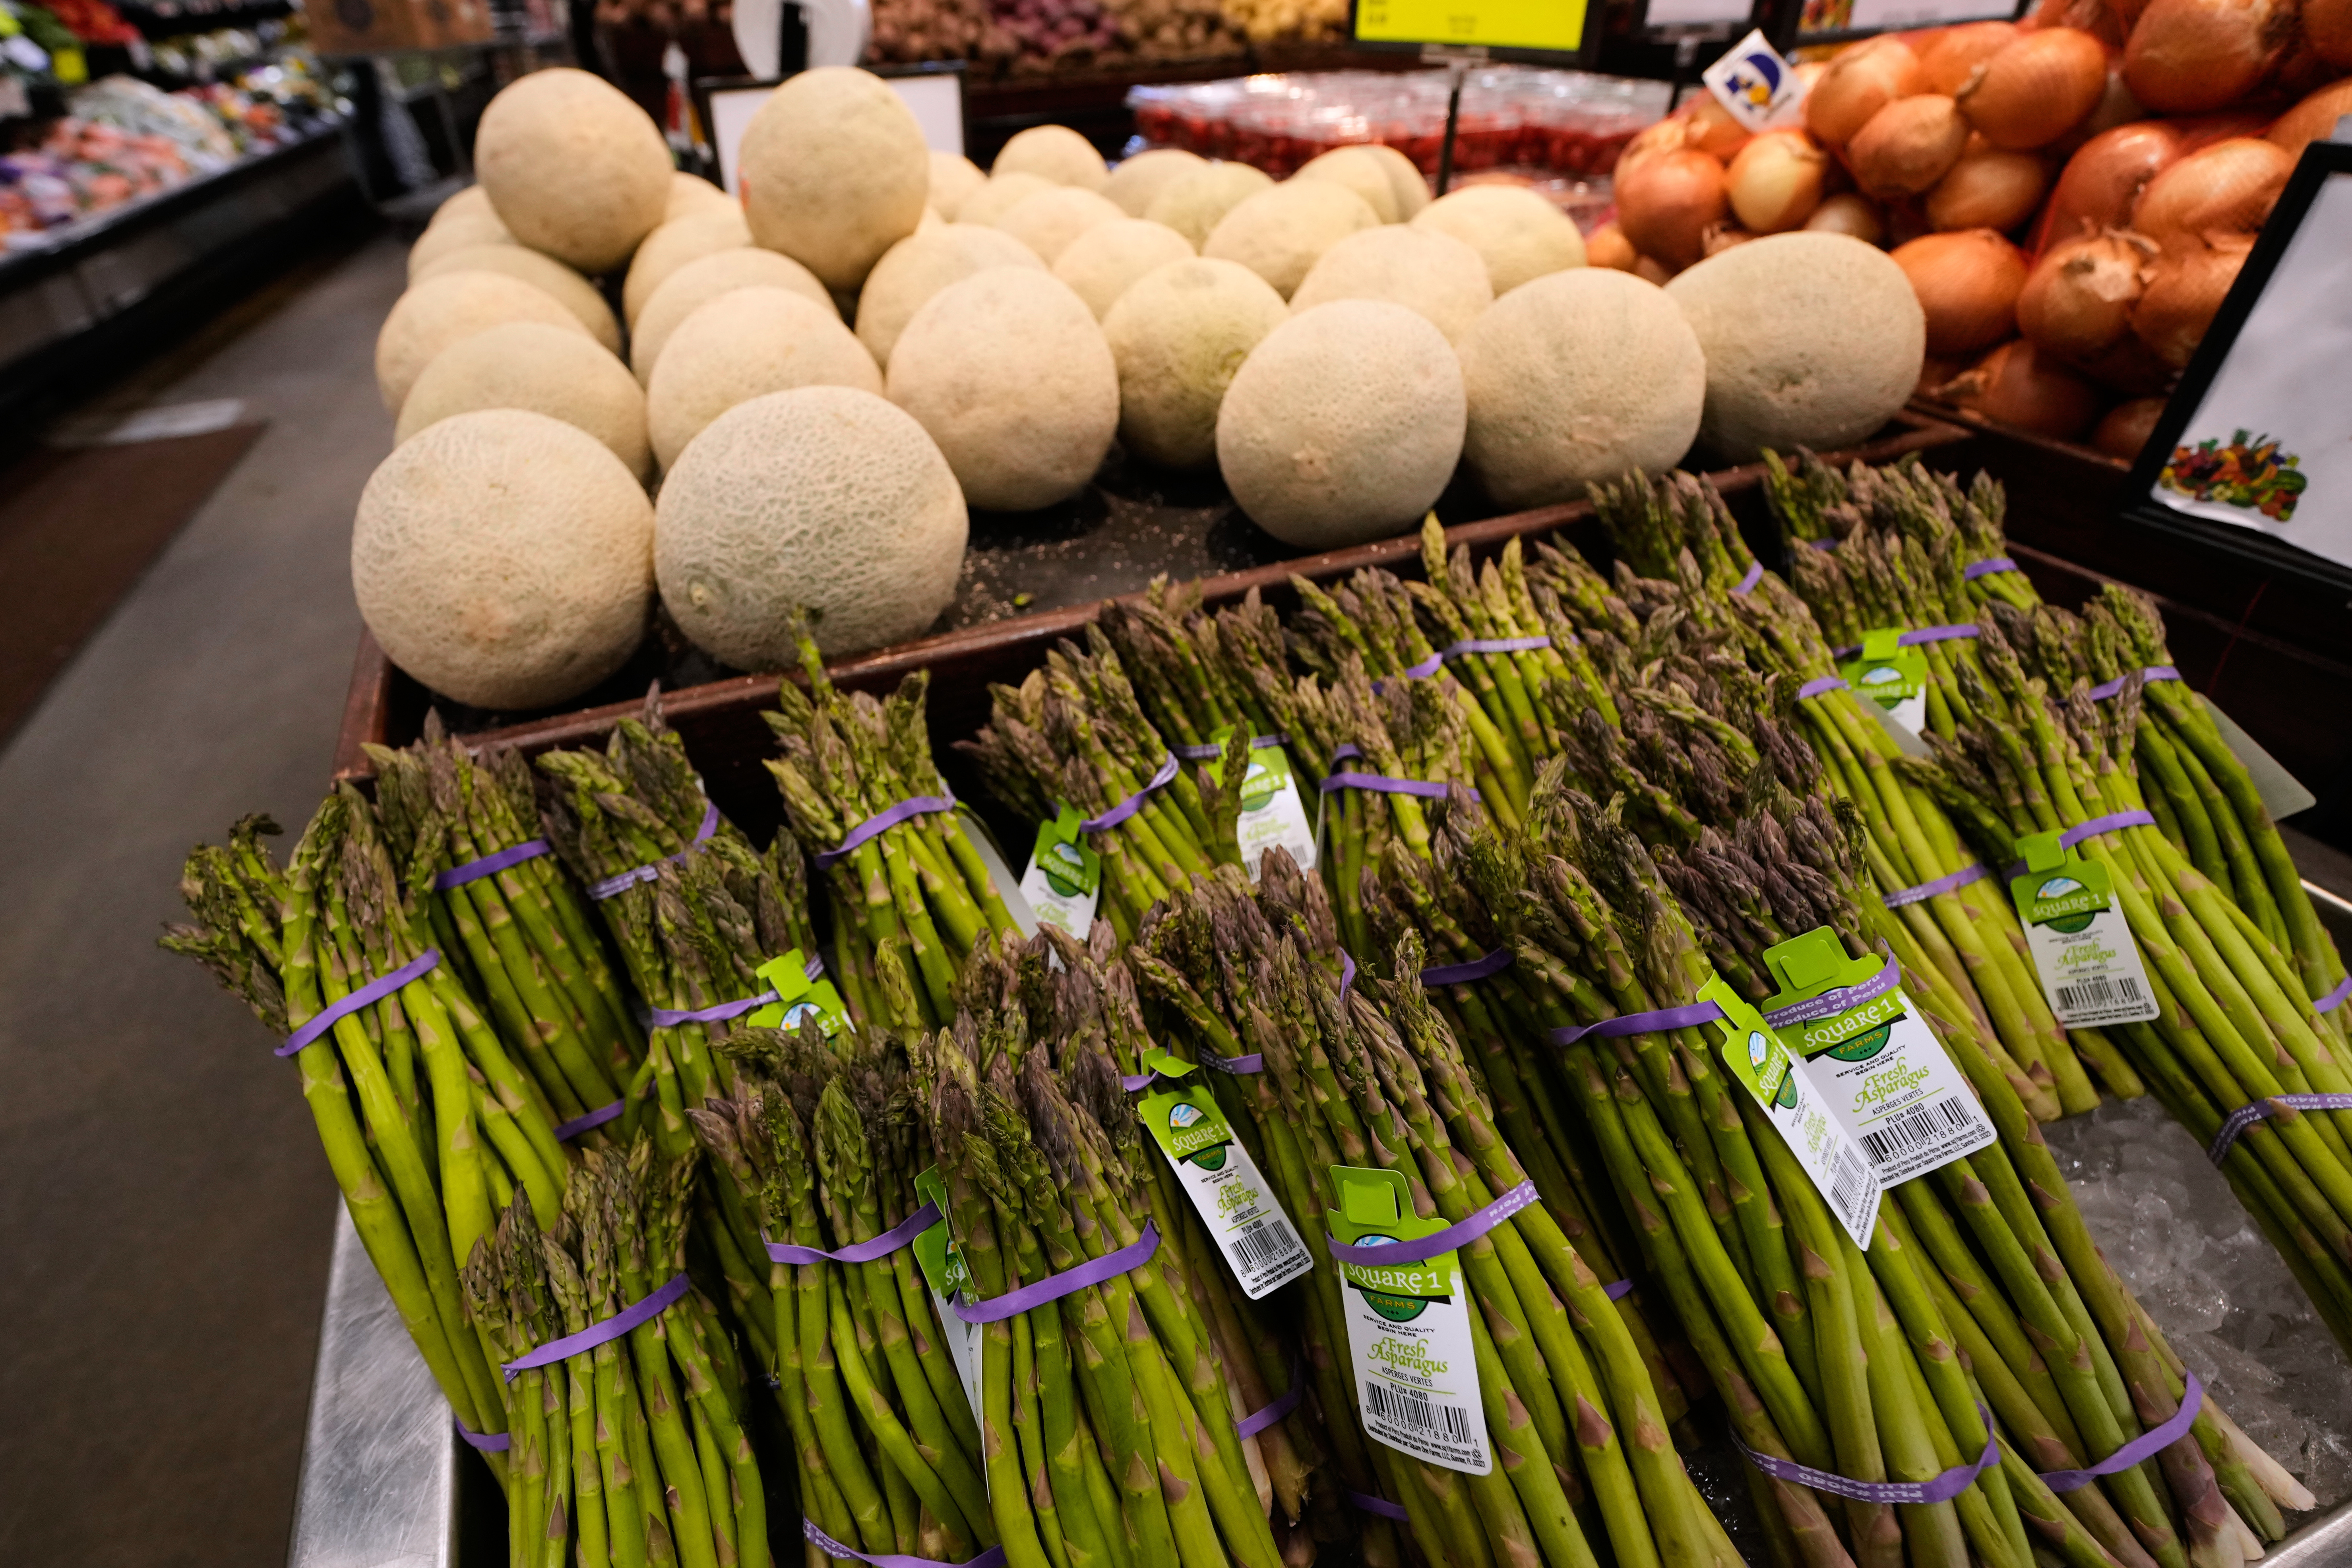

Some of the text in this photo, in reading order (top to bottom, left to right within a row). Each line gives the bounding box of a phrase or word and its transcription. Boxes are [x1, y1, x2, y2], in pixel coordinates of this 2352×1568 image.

[2092, 894, 2102, 904] 1
[1828, 992, 1843, 1001] of
[1848, 974, 1880, 995] Peru
[1832, 999, 1847, 1010] of
[1851, 982, 1886, 1003] Peru
[1880, 998, 1895, 1014] 1
[1775, 1045, 1784, 1060] 1
[1839, 1031, 1883, 1054] FARMS
[1836, 1045, 1906, 1078] SERVICE AND QUALITY
[1855, 1056, 1895, 1076] BEGIN HERE
[1865, 1056, 1908, 1088] Fresh
[1780, 1077, 1792, 1101] FARMS
[1852, 1066, 1930, 1113] Asparagus
[1872, 1088, 1924, 1116] ASPERGES VERTES
[1885, 1103, 1925, 1125] PLU# 4080
[1215, 1123, 1225, 1136] 1
[1882, 1164, 1897, 1174] Product
[1901, 1159, 1910, 1167] Peru
[1909, 1153, 1924, 1163] Produit
[1940, 1130, 1977, 1149] www.sq1farms.com
[1885, 1142, 1922, 1162] 60000
[1926, 1123, 1963, 1145] 21880
[1197, 1149, 1222, 1162] FARMS
[1921, 1157, 1935, 1166] Square
[1201, 1175, 1217, 1183] SERVICE
[1224, 1165, 1239, 1174] QUALITY
[1220, 1175, 1244, 1196] Fresh
[1217, 1187, 1259, 1219] Asparagus
[1489, 1193, 1521, 1217] Peru
[1240, 1270, 1246, 1278] 8
[1250, 1255, 1272, 1272] 60000
[1271, 1244, 1292, 1261] 21880
[1427, 1271, 1443, 1288] 1
[1370, 1295, 1416, 1309] FARMS
[1363, 1314, 1387, 1327] SERVICE
[1377, 1325, 1397, 1334] BEGIN
[1382, 1337, 1429, 1358] Fresh
[1367, 1343, 1449, 1378] Asparagus
[1381, 1366, 1434, 1387] ASPERGES VERTES
[1390, 1382, 1428, 1401] PLU# 4080
[1366, 1405, 1479, 1448] 8 60000 21880 1
[1375, 1419, 1388, 1431] Product
[1391, 1427, 1400, 1436] Peru
[1409, 1440, 1422, 1452] Square
[1798, 1472, 1872, 1497] #4080
